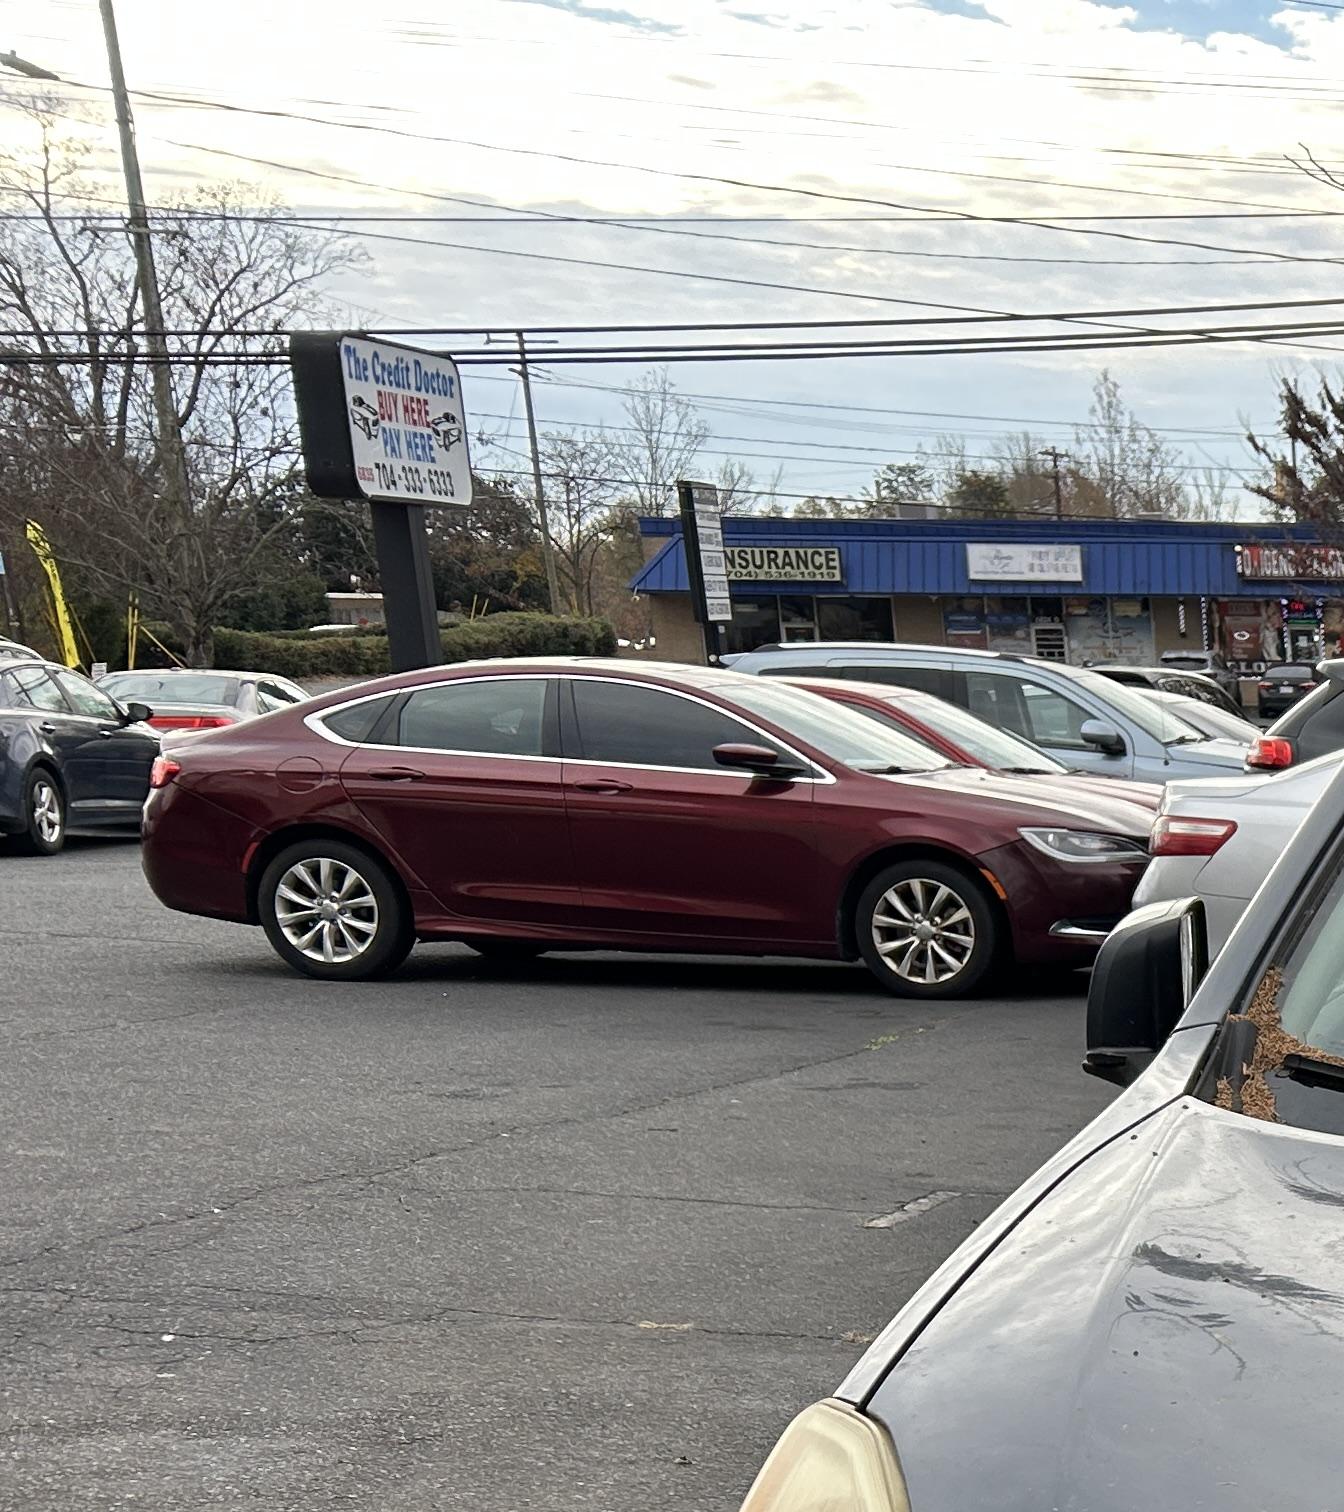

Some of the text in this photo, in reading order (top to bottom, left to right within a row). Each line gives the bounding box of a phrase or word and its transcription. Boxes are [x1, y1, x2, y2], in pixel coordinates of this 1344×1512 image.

[344, 344, 454, 397] The Credit Doctor
[376, 390, 432, 428] BUY HERE
[380, 426, 436, 463] PAY HERE
[724, 549, 837, 570] NSURANCE
